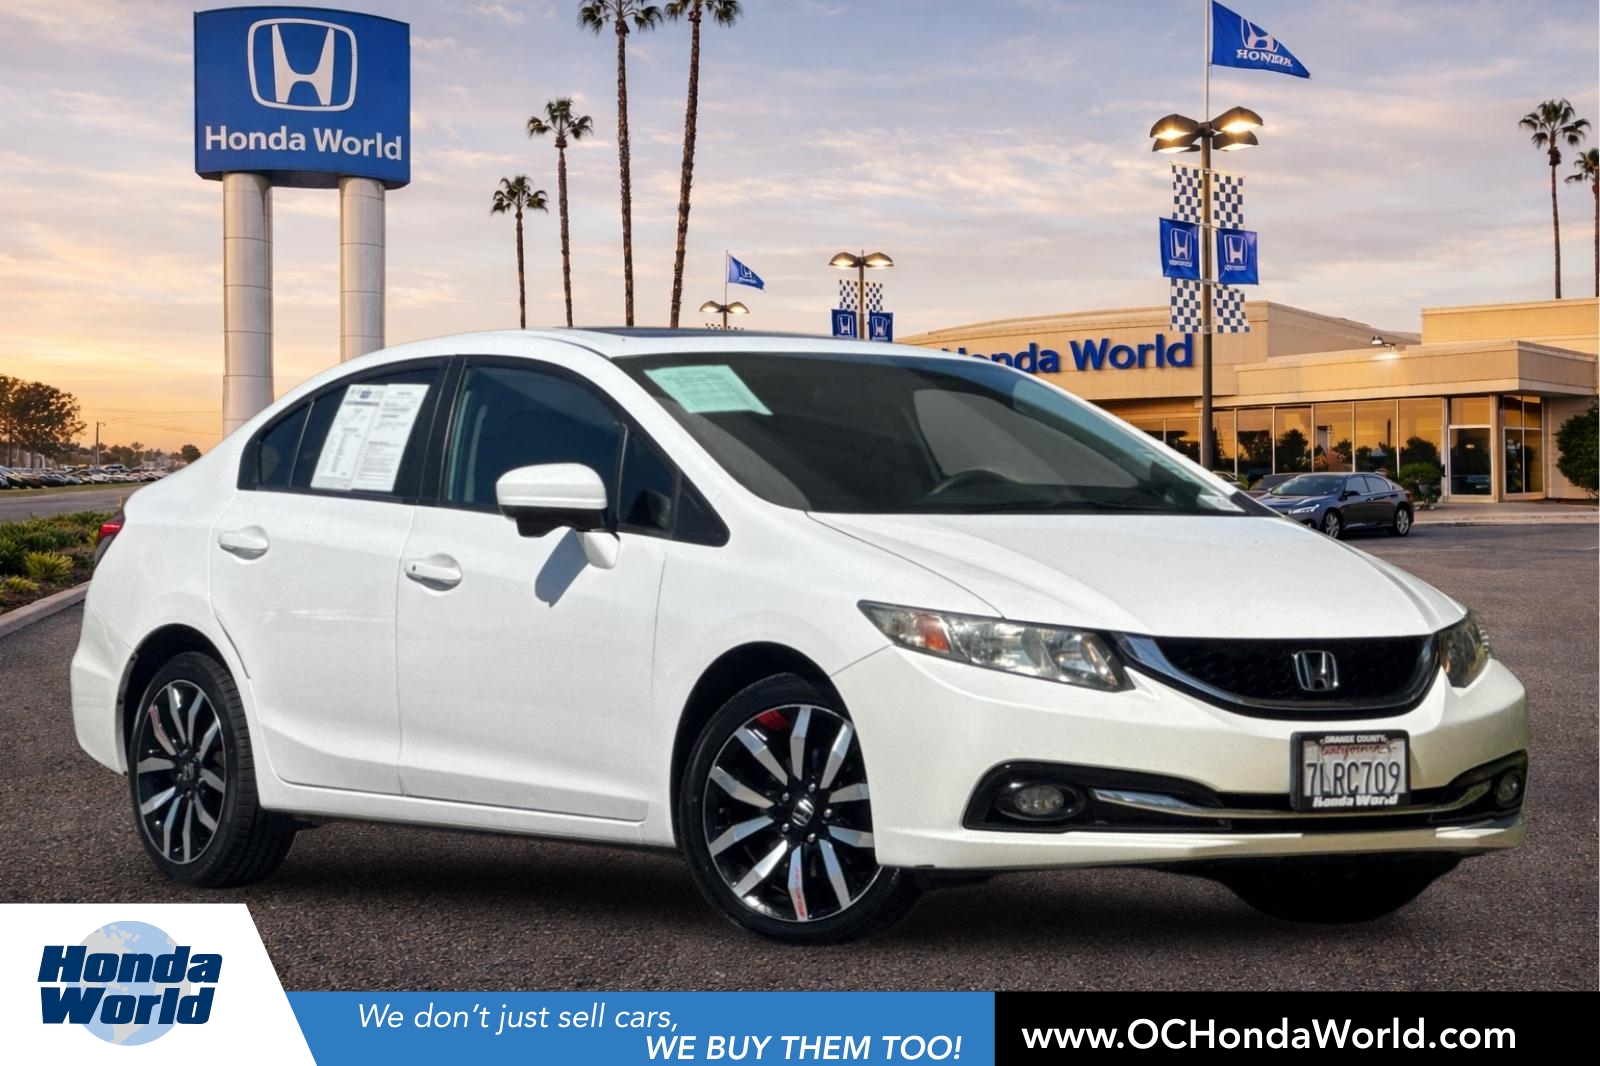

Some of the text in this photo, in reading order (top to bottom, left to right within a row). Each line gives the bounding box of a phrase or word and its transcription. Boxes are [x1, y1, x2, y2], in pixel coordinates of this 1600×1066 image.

[205, 125, 402, 161] Honda World
[1070, 333, 1194, 371] World
[1324, 734, 1387, 744] ORANGE COUNTY
[1306, 761, 1401, 796] 7LRC709
[1312, 794, 1399, 808] Honda World
